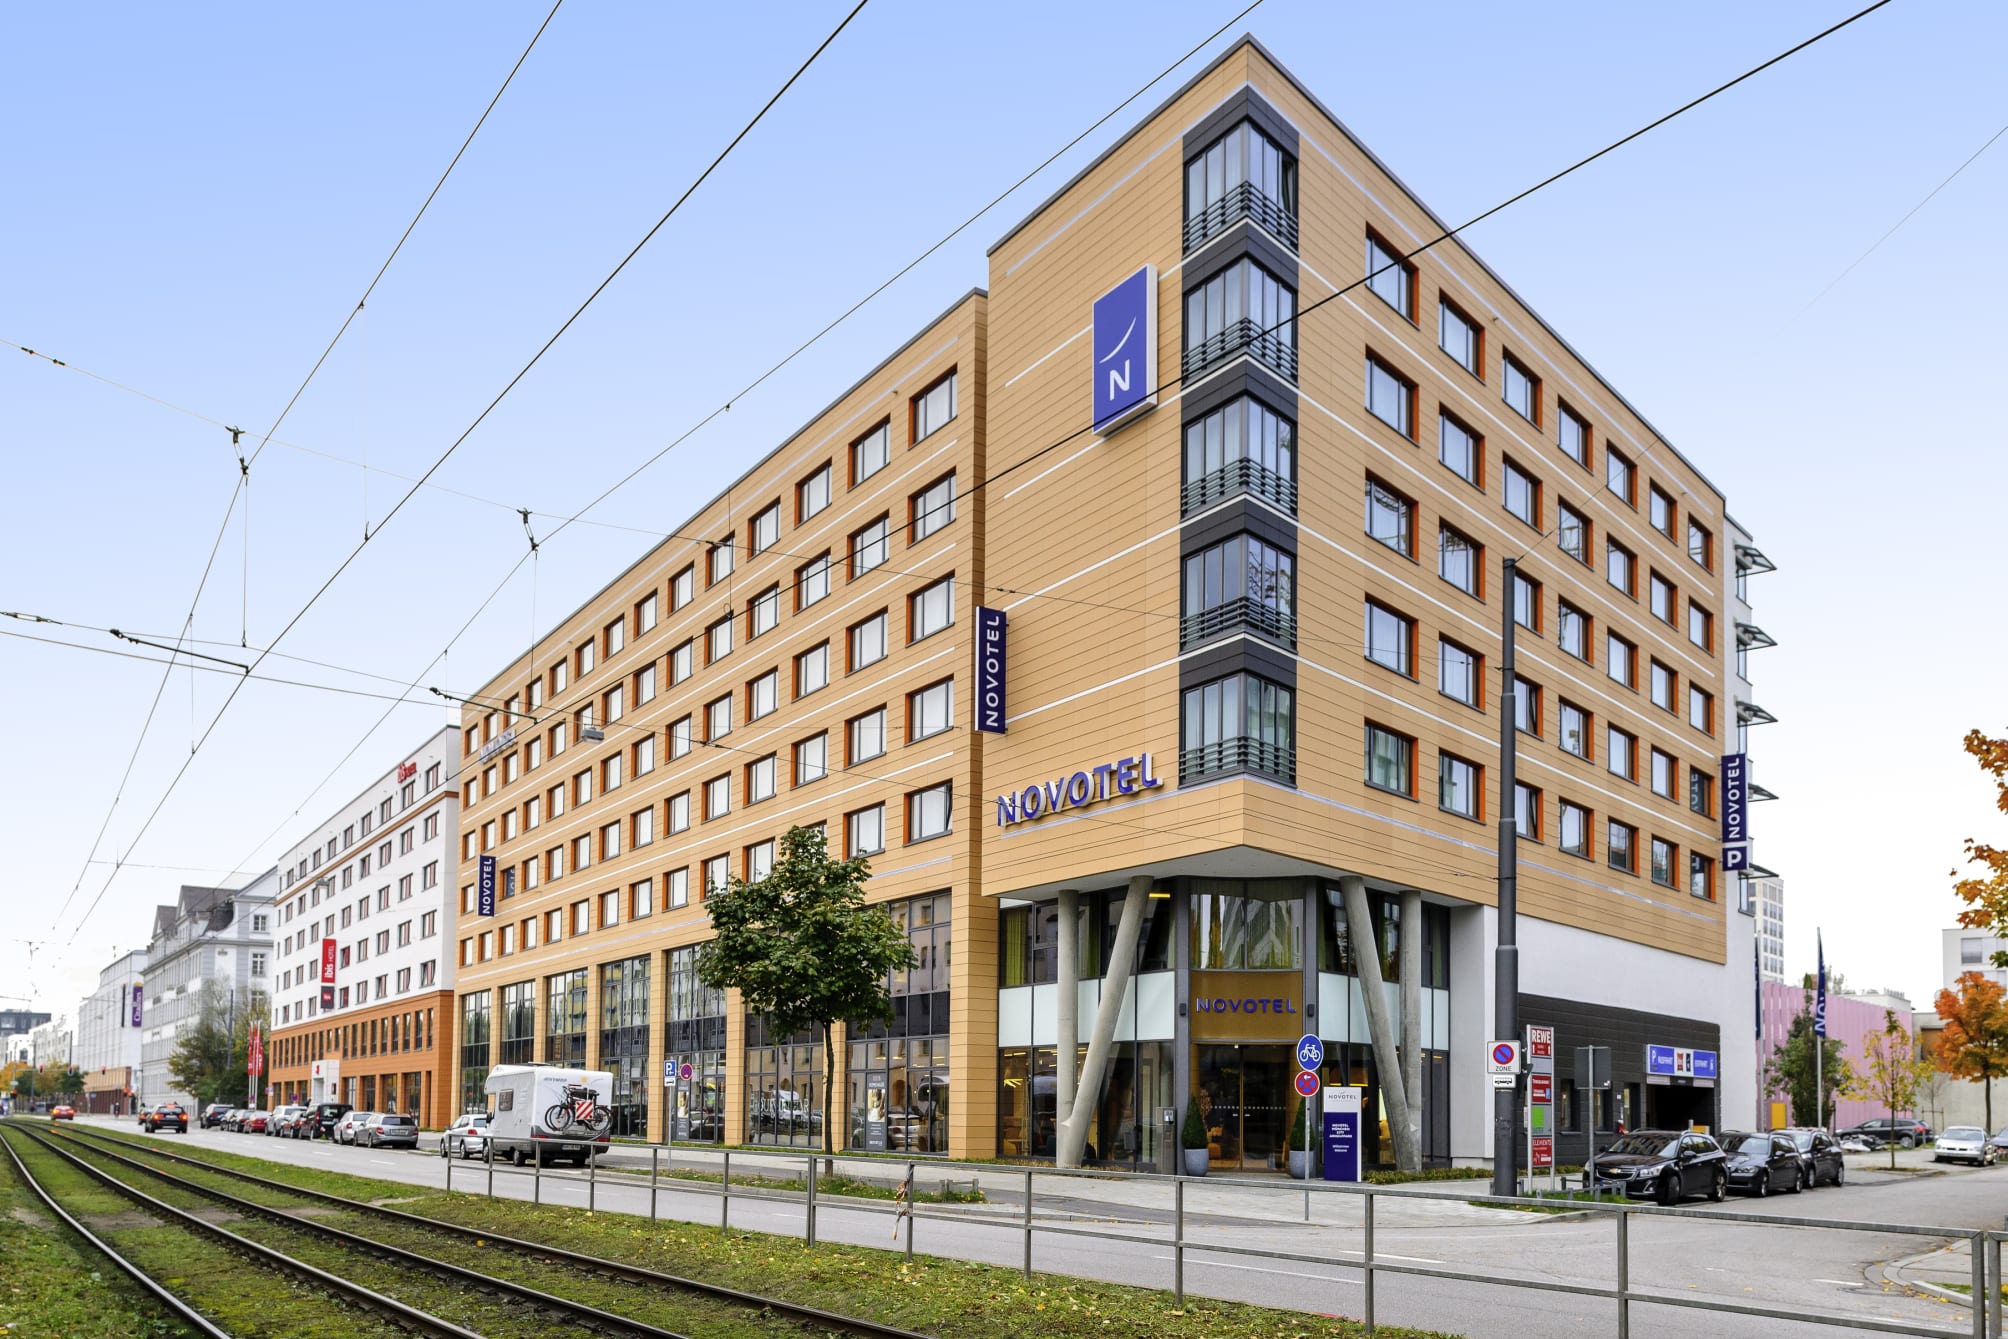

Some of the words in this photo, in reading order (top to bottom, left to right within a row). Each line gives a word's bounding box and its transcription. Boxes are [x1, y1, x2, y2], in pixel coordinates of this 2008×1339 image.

[1109, 359, 1130, 401] N
[985, 615, 1000, 727] NOVOTEL
[998, 752, 1163, 827] NOVOTEL
[1727, 757, 1740, 839] NOVOTEL
[482, 858, 492, 914] NOVOTEL
[324, 963, 334, 979] ibis
[1196, 998, 1296, 1014] NOVOTEL
[1531, 1029, 1551, 1044] REWE
